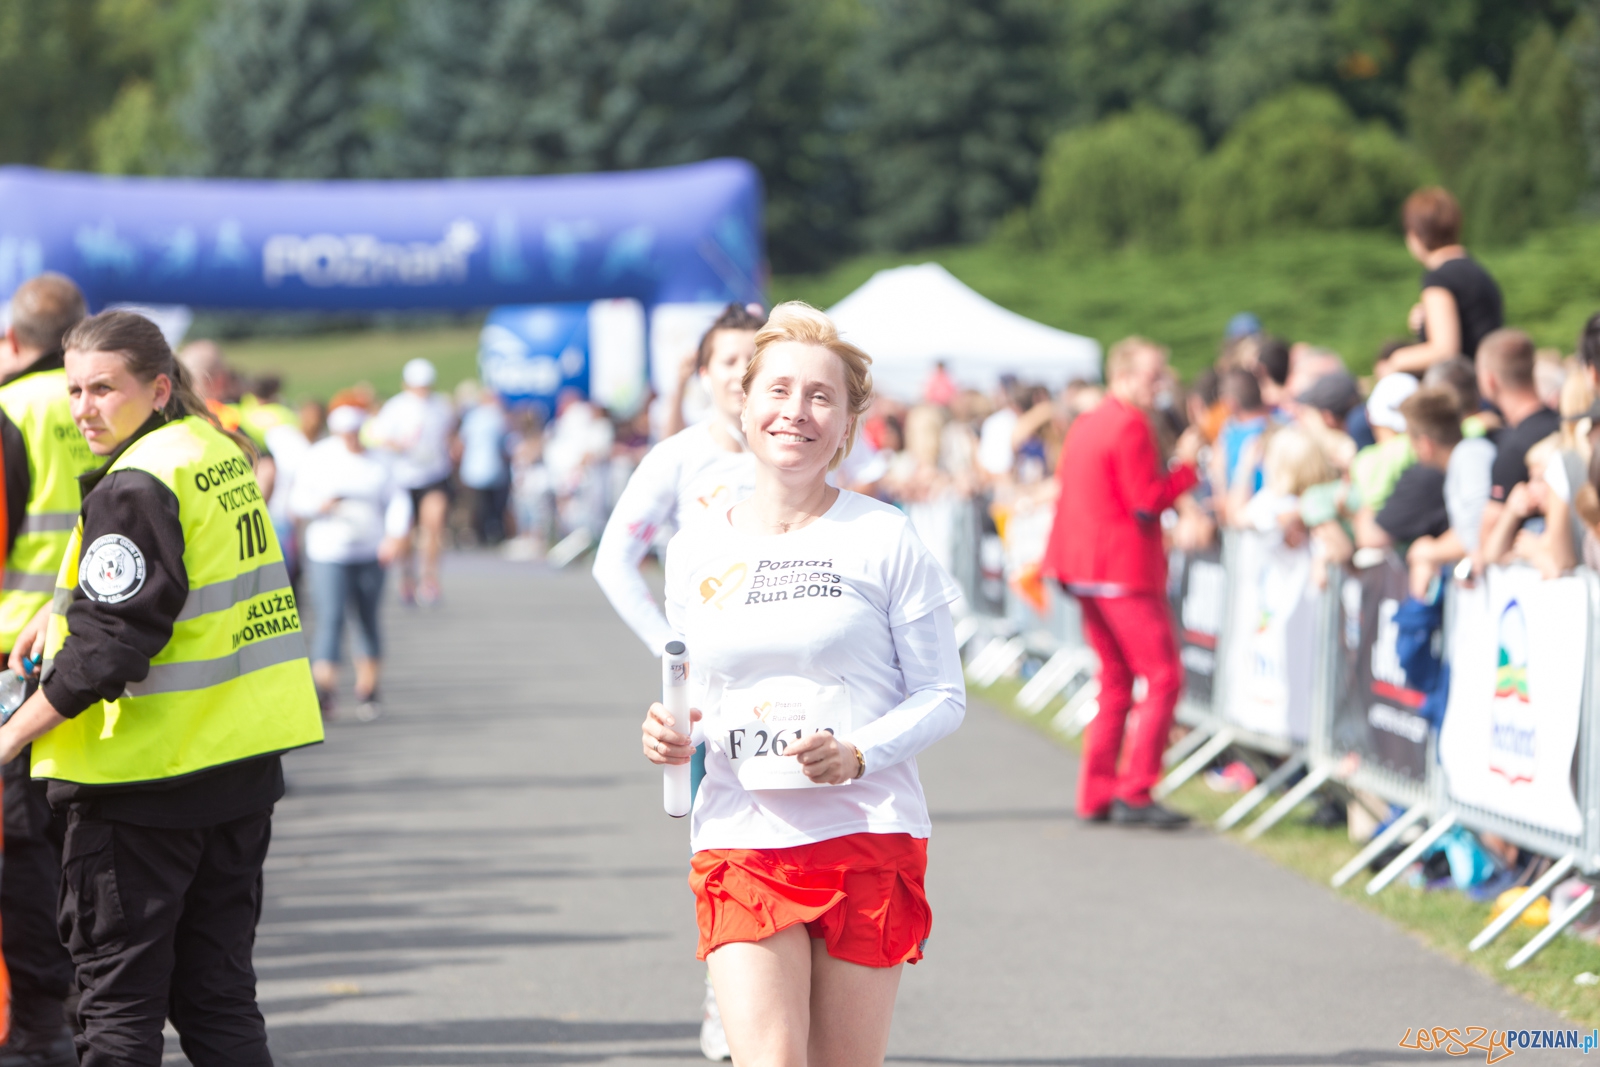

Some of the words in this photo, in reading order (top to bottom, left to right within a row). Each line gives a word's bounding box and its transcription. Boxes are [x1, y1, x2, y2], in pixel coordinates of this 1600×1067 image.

[217, 481, 261, 513] VICTOR
[755, 559, 833, 573] Poznań
[750, 570, 842, 589] Business
[745, 590, 788, 605] Run
[793, 584, 842, 599] 2016
[728, 729, 746, 759] F
